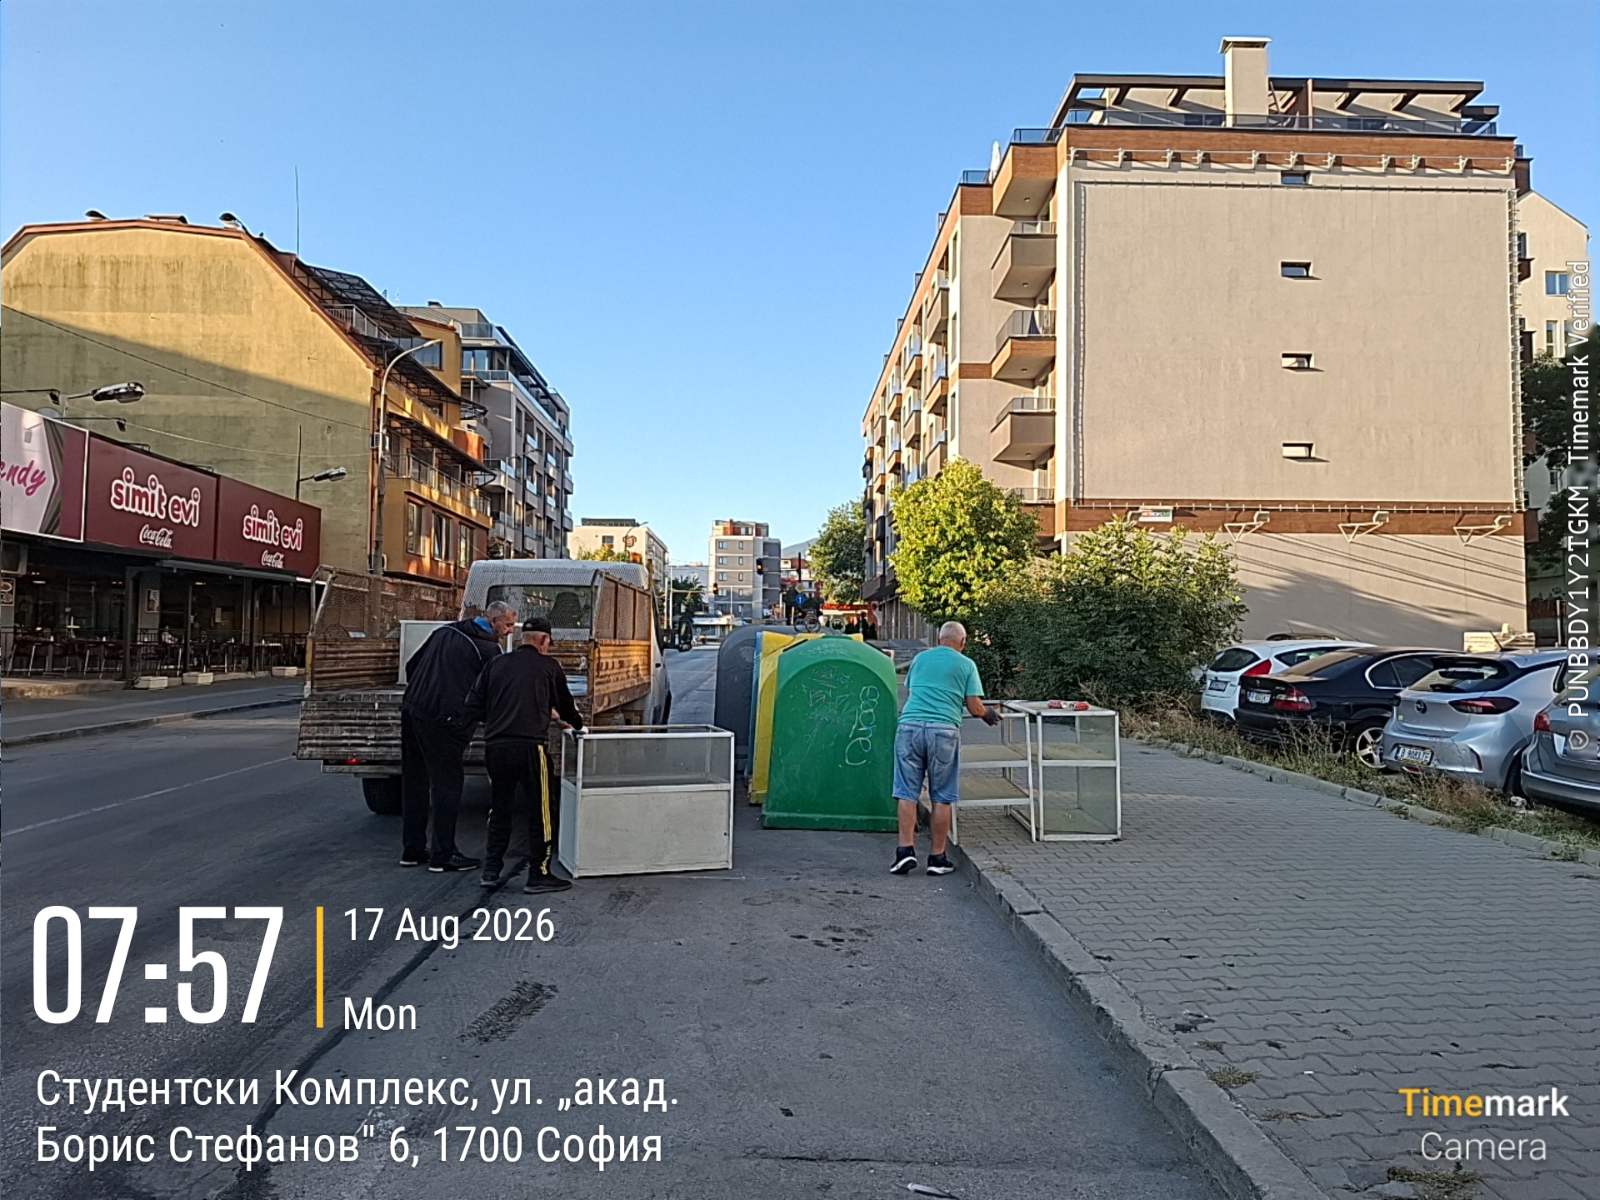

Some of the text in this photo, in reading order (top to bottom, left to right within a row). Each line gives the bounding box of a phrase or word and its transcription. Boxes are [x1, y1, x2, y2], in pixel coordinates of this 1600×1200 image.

[110, 466, 201, 527] simit evi
[243, 504, 303, 551] simit evi
